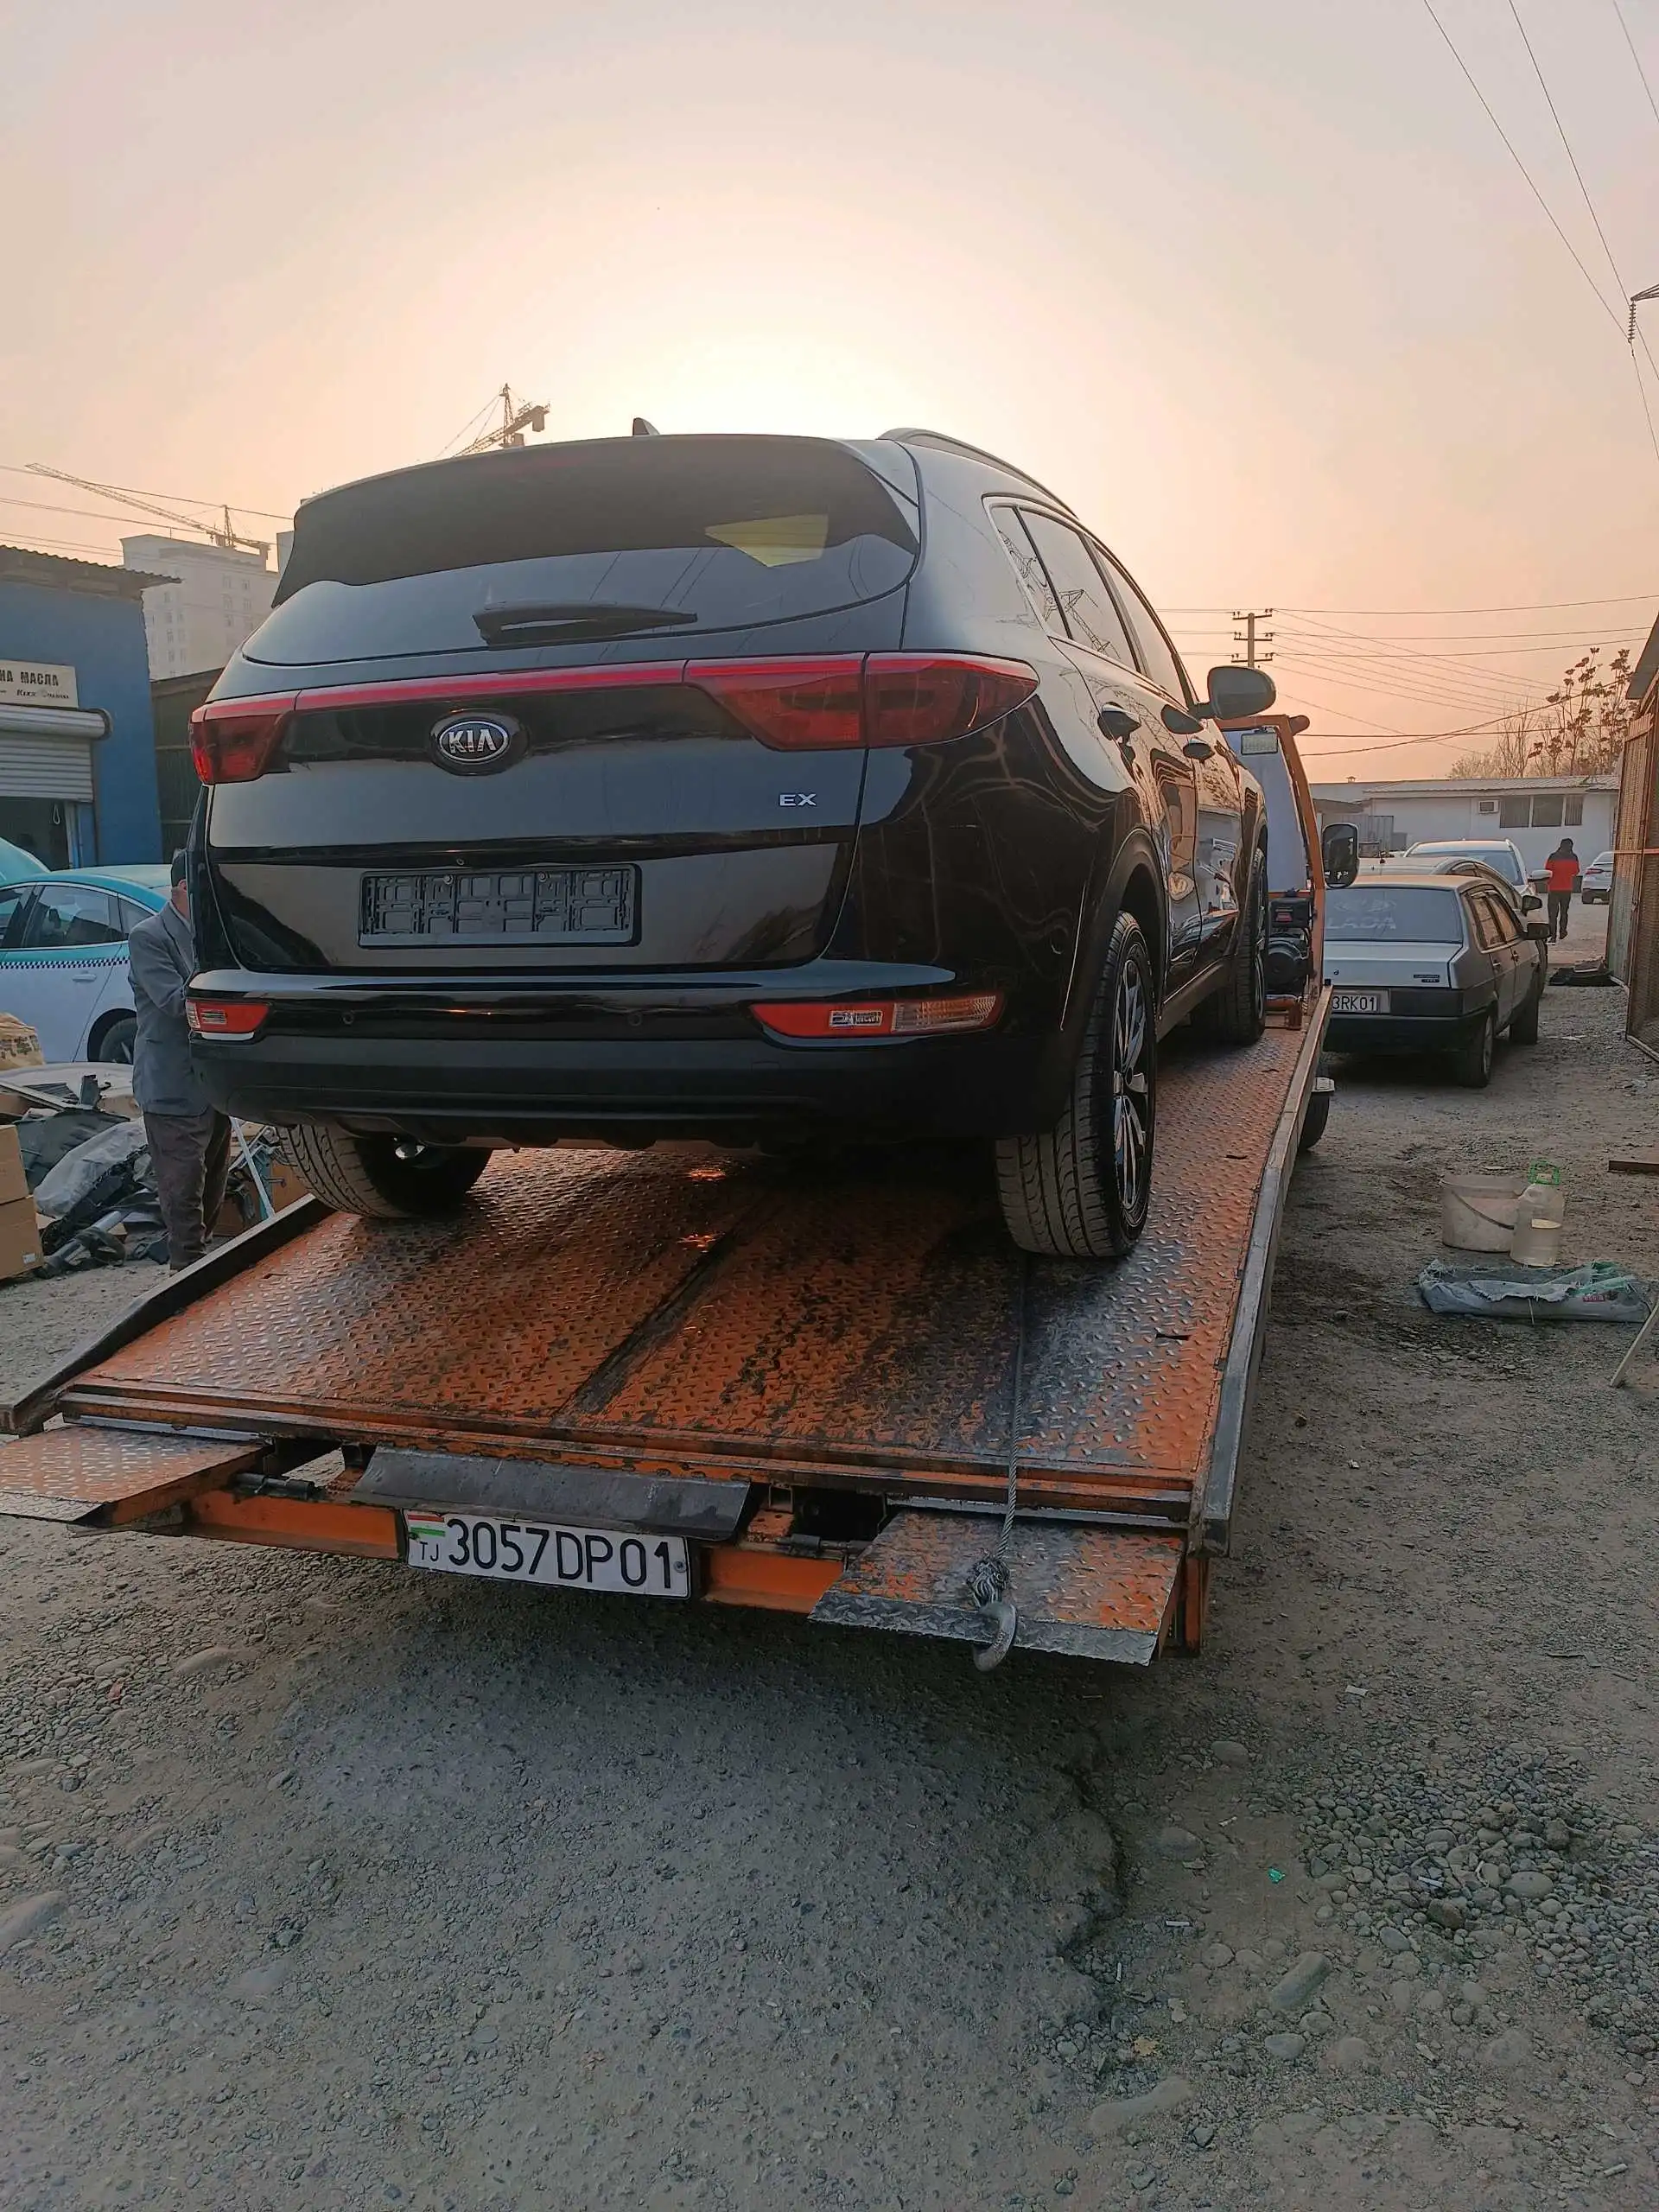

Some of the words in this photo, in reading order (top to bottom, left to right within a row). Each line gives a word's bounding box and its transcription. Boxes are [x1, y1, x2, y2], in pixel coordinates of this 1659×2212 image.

[21, 671, 59, 686] МАСЛА
[448, 728, 497, 753] KIA
[779, 793, 817, 806] EX
[1325, 916, 1397, 930] LADA
[419, 1541, 440, 1562] TJ
[447, 1518, 671, 1589] 3057DP01
